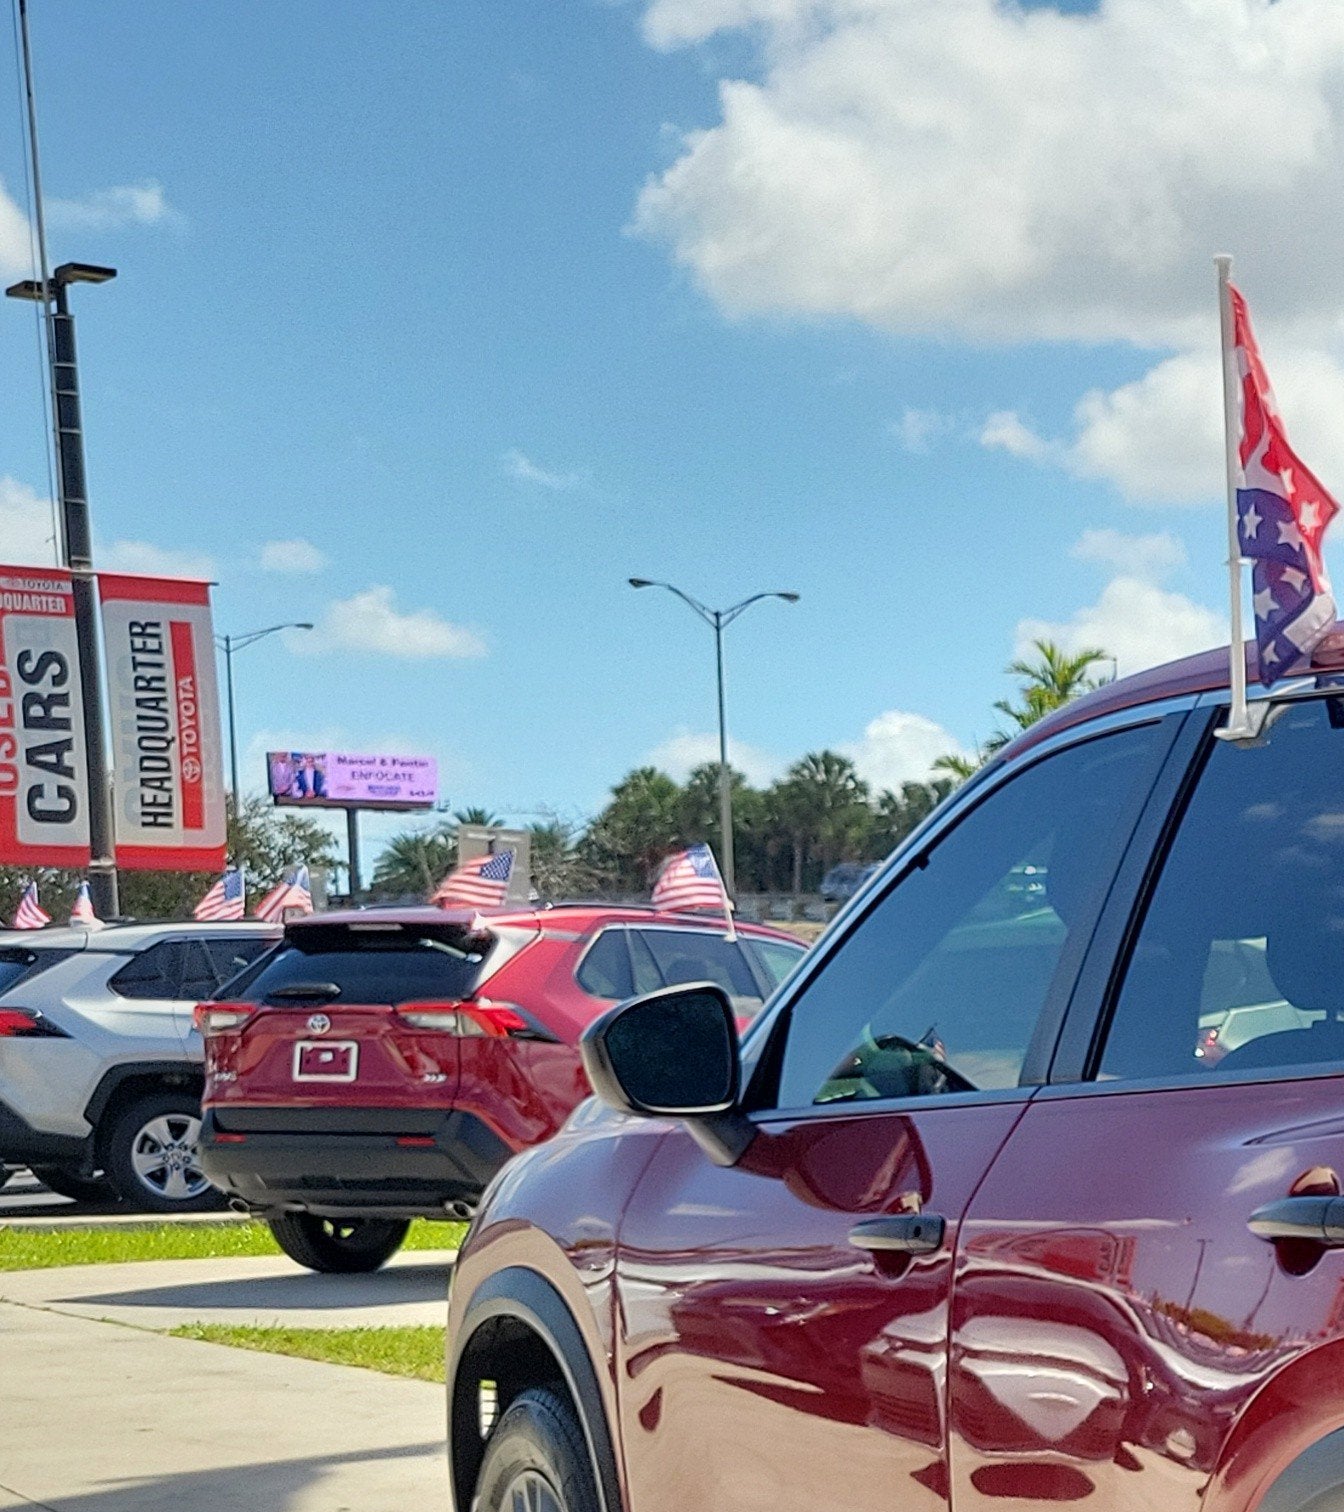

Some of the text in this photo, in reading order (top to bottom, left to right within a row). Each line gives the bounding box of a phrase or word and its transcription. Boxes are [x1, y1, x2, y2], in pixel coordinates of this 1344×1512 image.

[22, 580, 64, 591] TOYOTA
[16, 648, 78, 824] CARS
[128, 619, 176, 830] HEADQUARTER
[177, 674, 200, 756] TOYOTA
